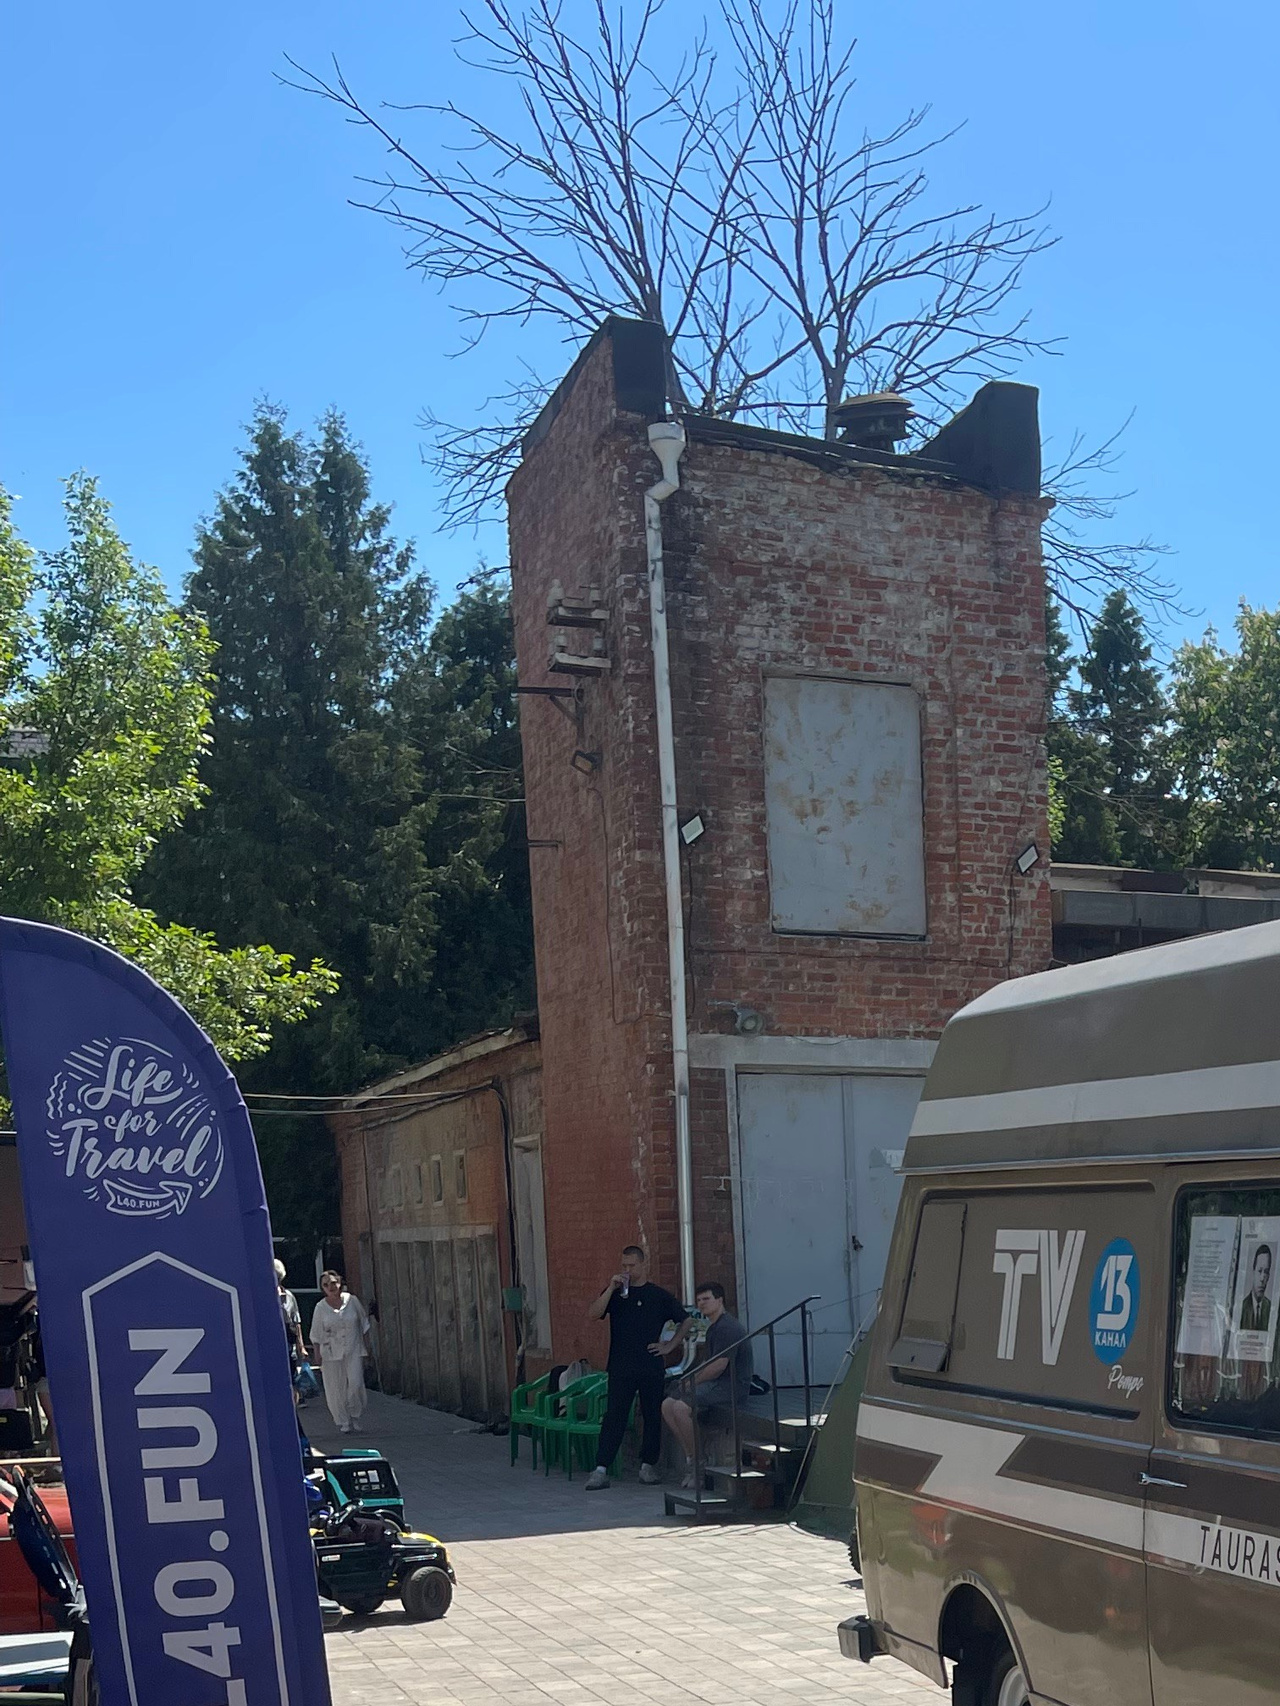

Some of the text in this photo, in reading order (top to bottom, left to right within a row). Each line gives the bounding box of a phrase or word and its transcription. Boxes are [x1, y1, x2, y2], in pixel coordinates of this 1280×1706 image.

[84, 1045, 183, 1111] Life
[61, 1117, 213, 1180] Travel
[104, 1108, 163, 1143] for
[116, 1194, 161, 1209] L40.FUN
[992, 1228, 1087, 1367] TV
[1096, 1254, 1134, 1331] 13
[1094, 1330, 1127, 1349] КАНАЛ
